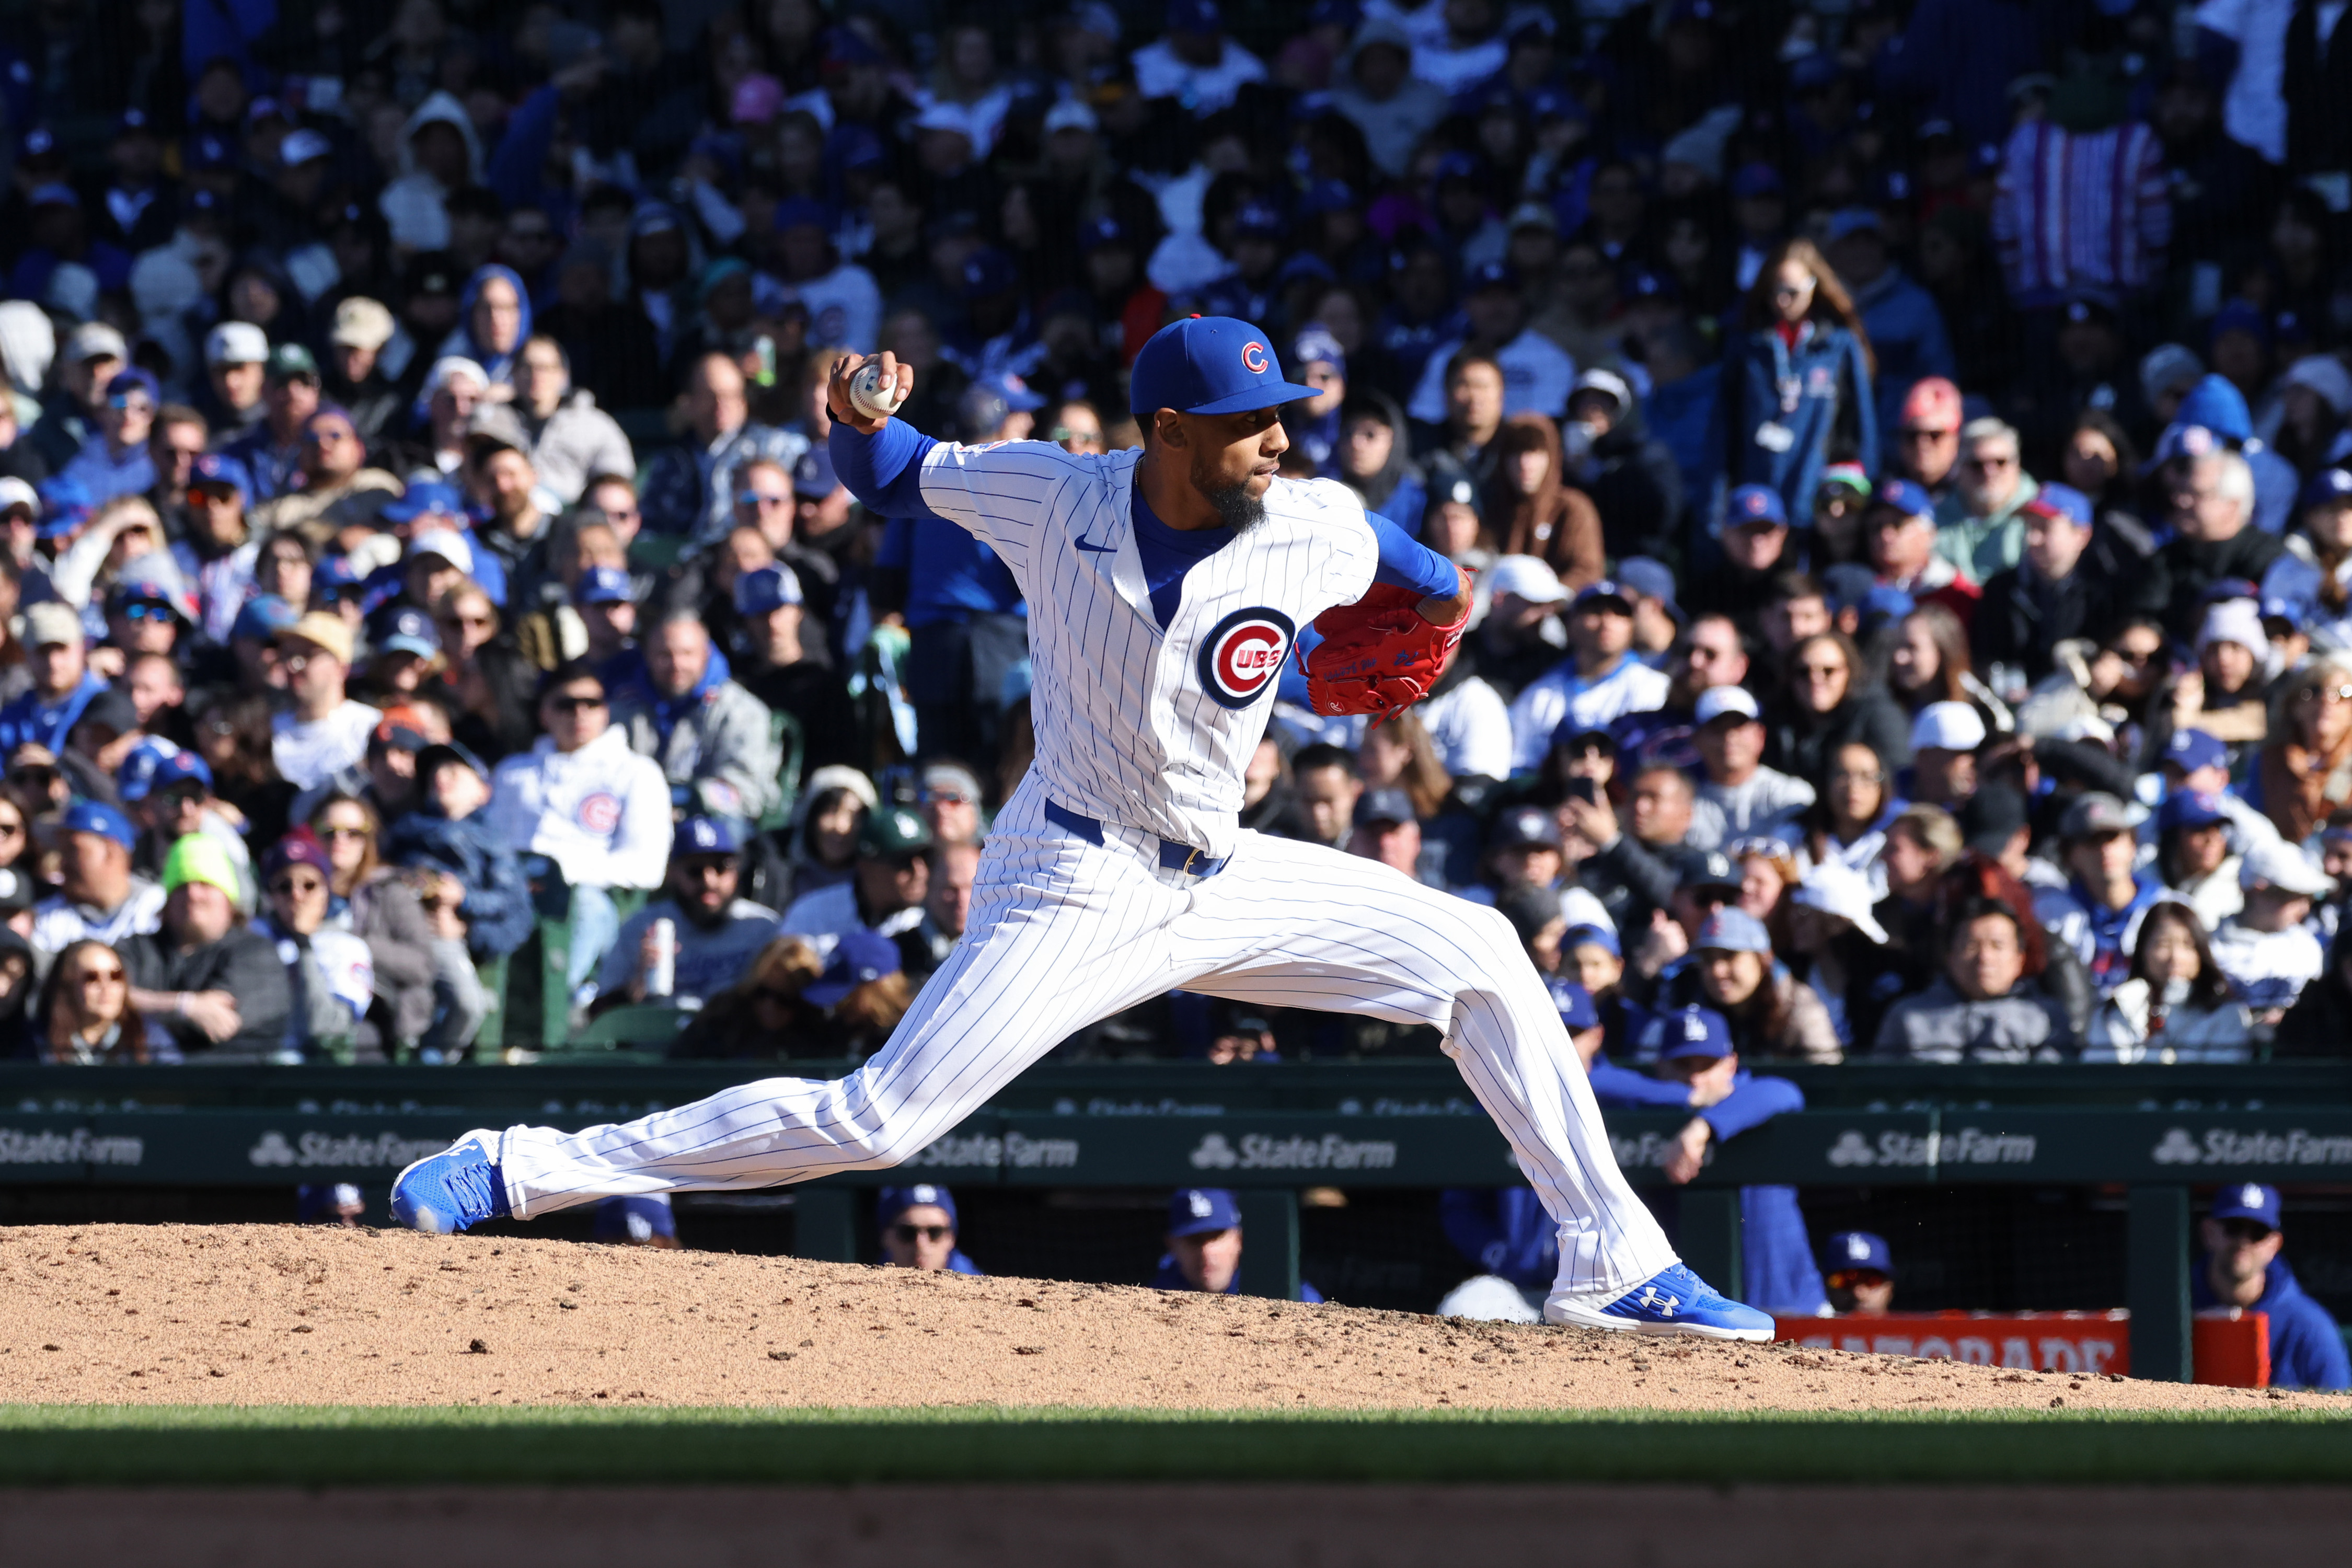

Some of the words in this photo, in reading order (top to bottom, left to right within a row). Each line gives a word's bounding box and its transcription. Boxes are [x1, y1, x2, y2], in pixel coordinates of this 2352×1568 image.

[1241, 341, 1269, 374] C
[1393, 650, 1419, 666] 74
[1239, 1133, 1396, 1168] StateFarm
[2201, 1128, 2352, 1165] StateFarm
[1800, 1335, 2115, 1373] TORADE
